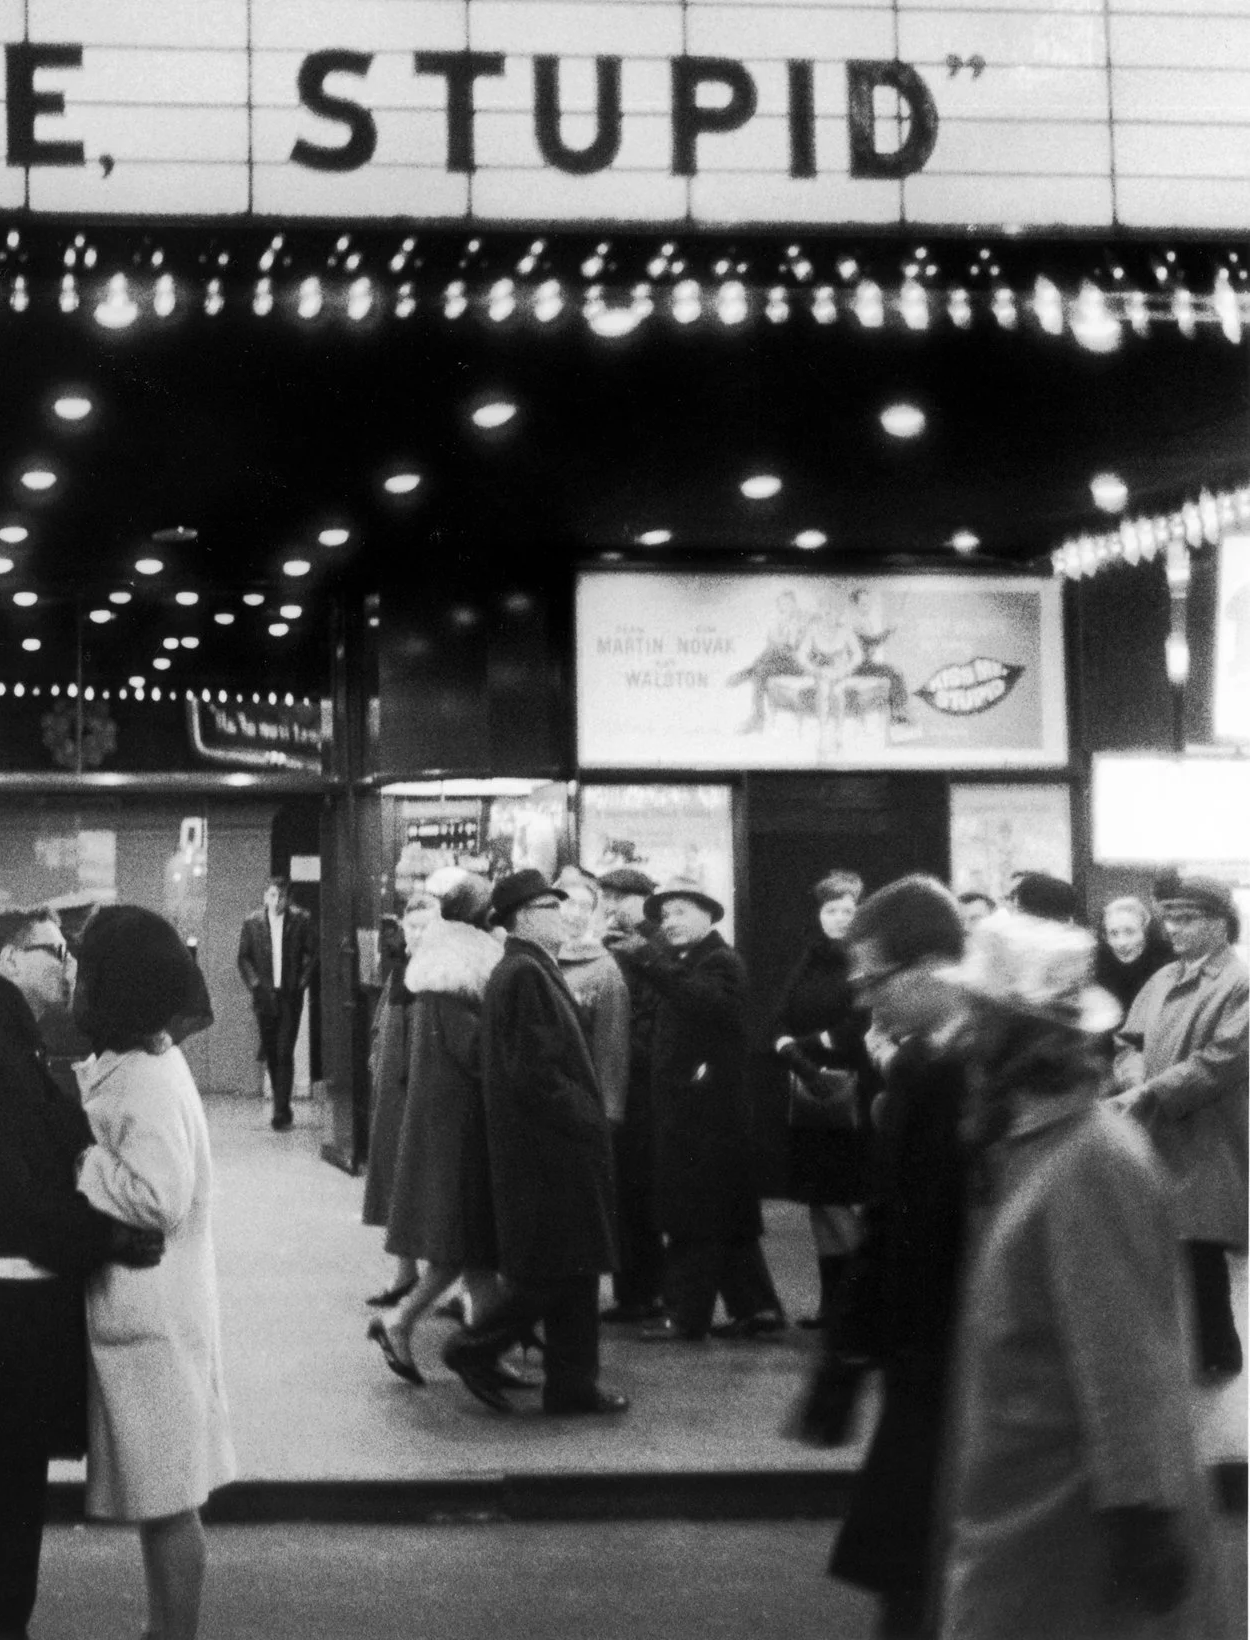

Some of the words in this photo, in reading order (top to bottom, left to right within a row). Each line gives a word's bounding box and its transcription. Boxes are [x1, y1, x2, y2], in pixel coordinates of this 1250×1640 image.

[596, 637, 664, 655] MARTIN
[677, 637, 736, 654] NOVAK
[625, 670, 709, 688] WALSTON
